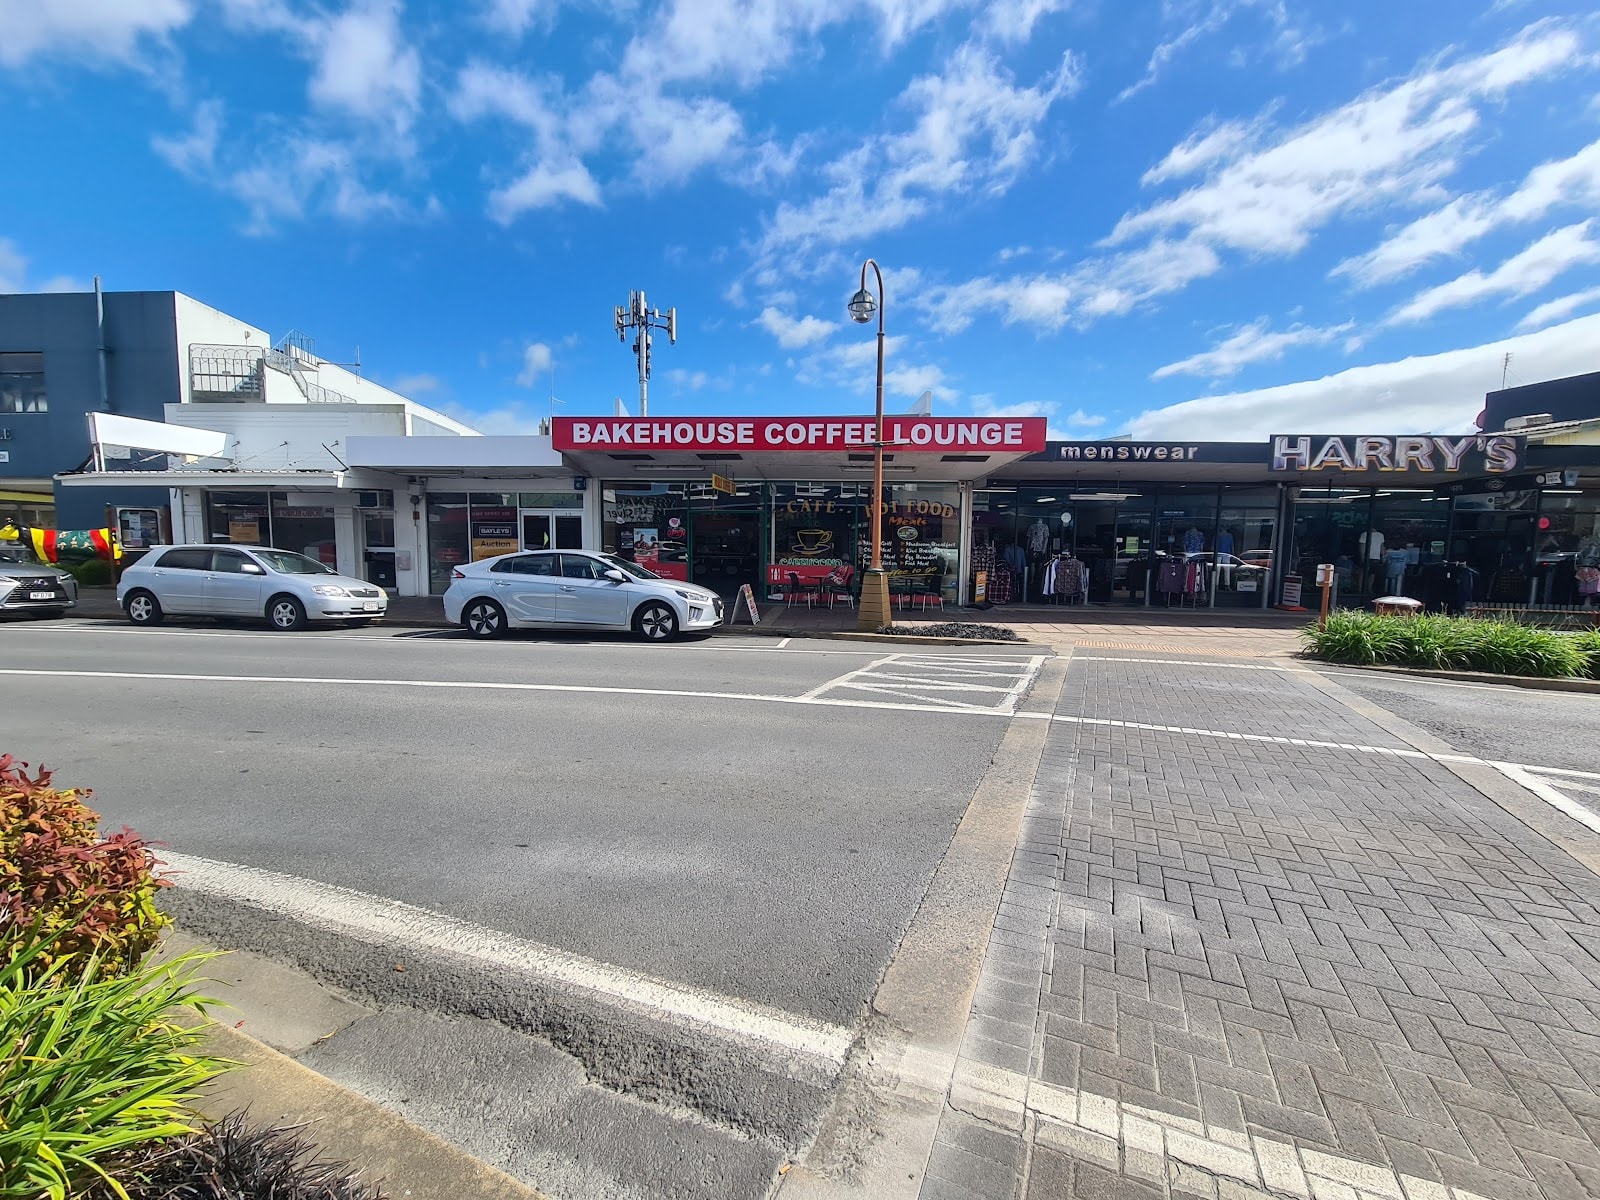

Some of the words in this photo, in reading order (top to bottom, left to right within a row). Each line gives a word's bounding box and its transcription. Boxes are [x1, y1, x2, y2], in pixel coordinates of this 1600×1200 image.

[572, 422, 755, 445] BAKEHOUSE
[764, 422, 879, 445] COFFEE
[893, 422, 1023, 445] LOUNGE
[1060, 444, 1199, 460] menswear
[1273, 436, 1518, 473] HARRY'S
[616, 496, 676, 510] BAKERY
[787, 499, 836, 514] CAFE
[907, 500, 954, 518] FOOD
[889, 516, 928, 526] Meals
[481, 540, 511, 548] Auction
